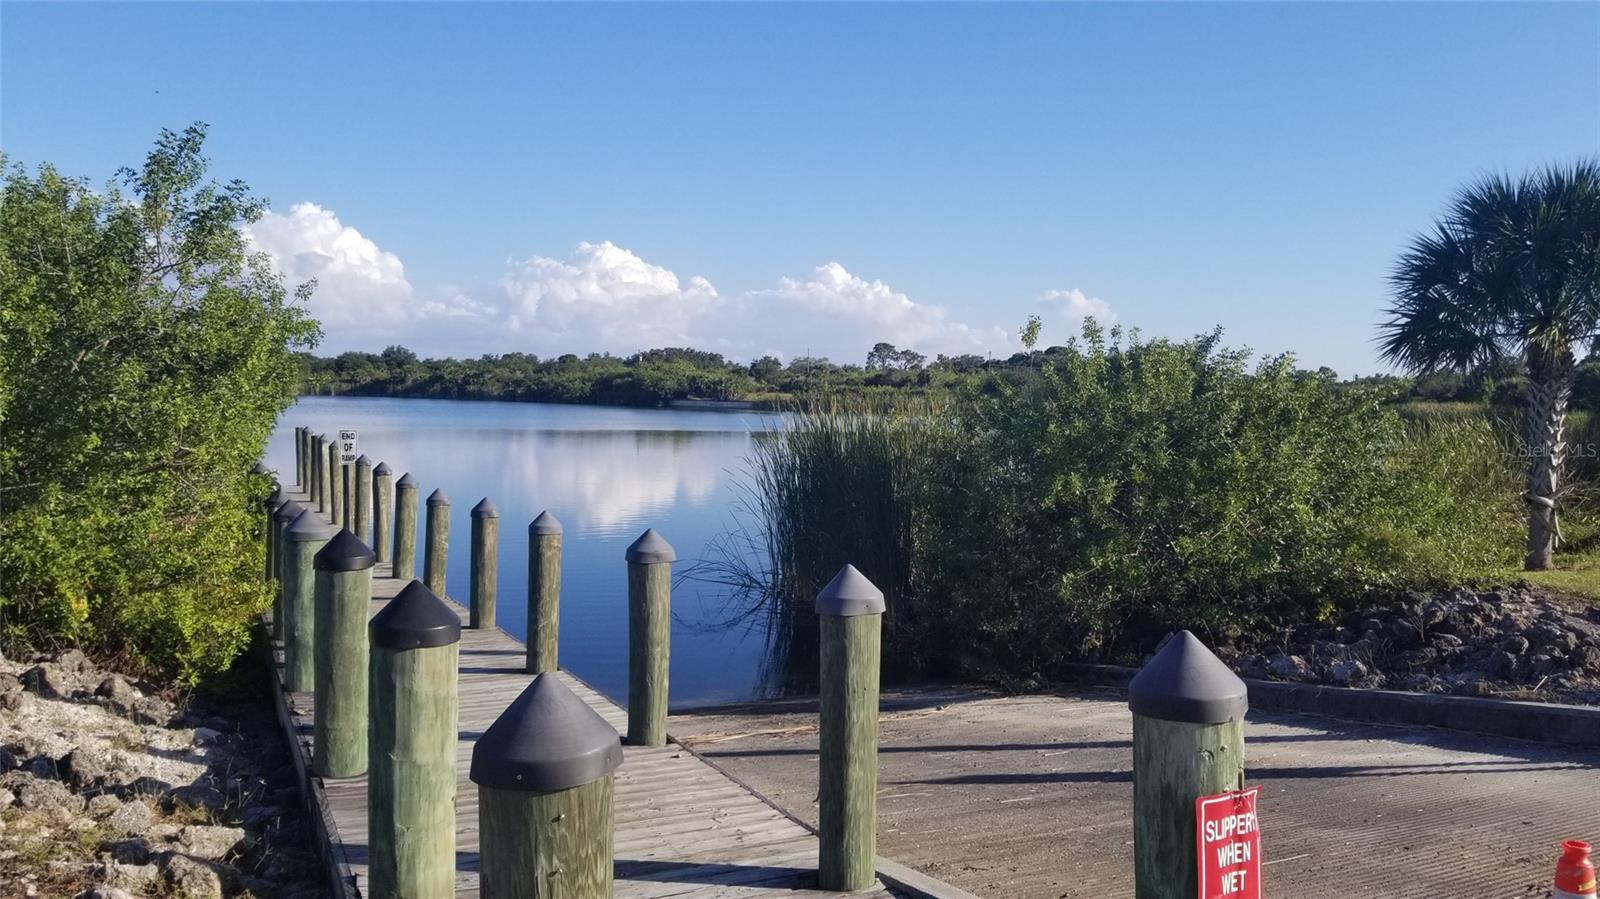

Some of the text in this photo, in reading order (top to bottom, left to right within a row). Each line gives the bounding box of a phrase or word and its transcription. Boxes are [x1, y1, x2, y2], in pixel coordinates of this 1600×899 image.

[342, 432, 355, 440] END
[344, 443, 353, 452] OF
[1217, 842, 1251, 868] WHEN
[1222, 870, 1247, 896] WET
